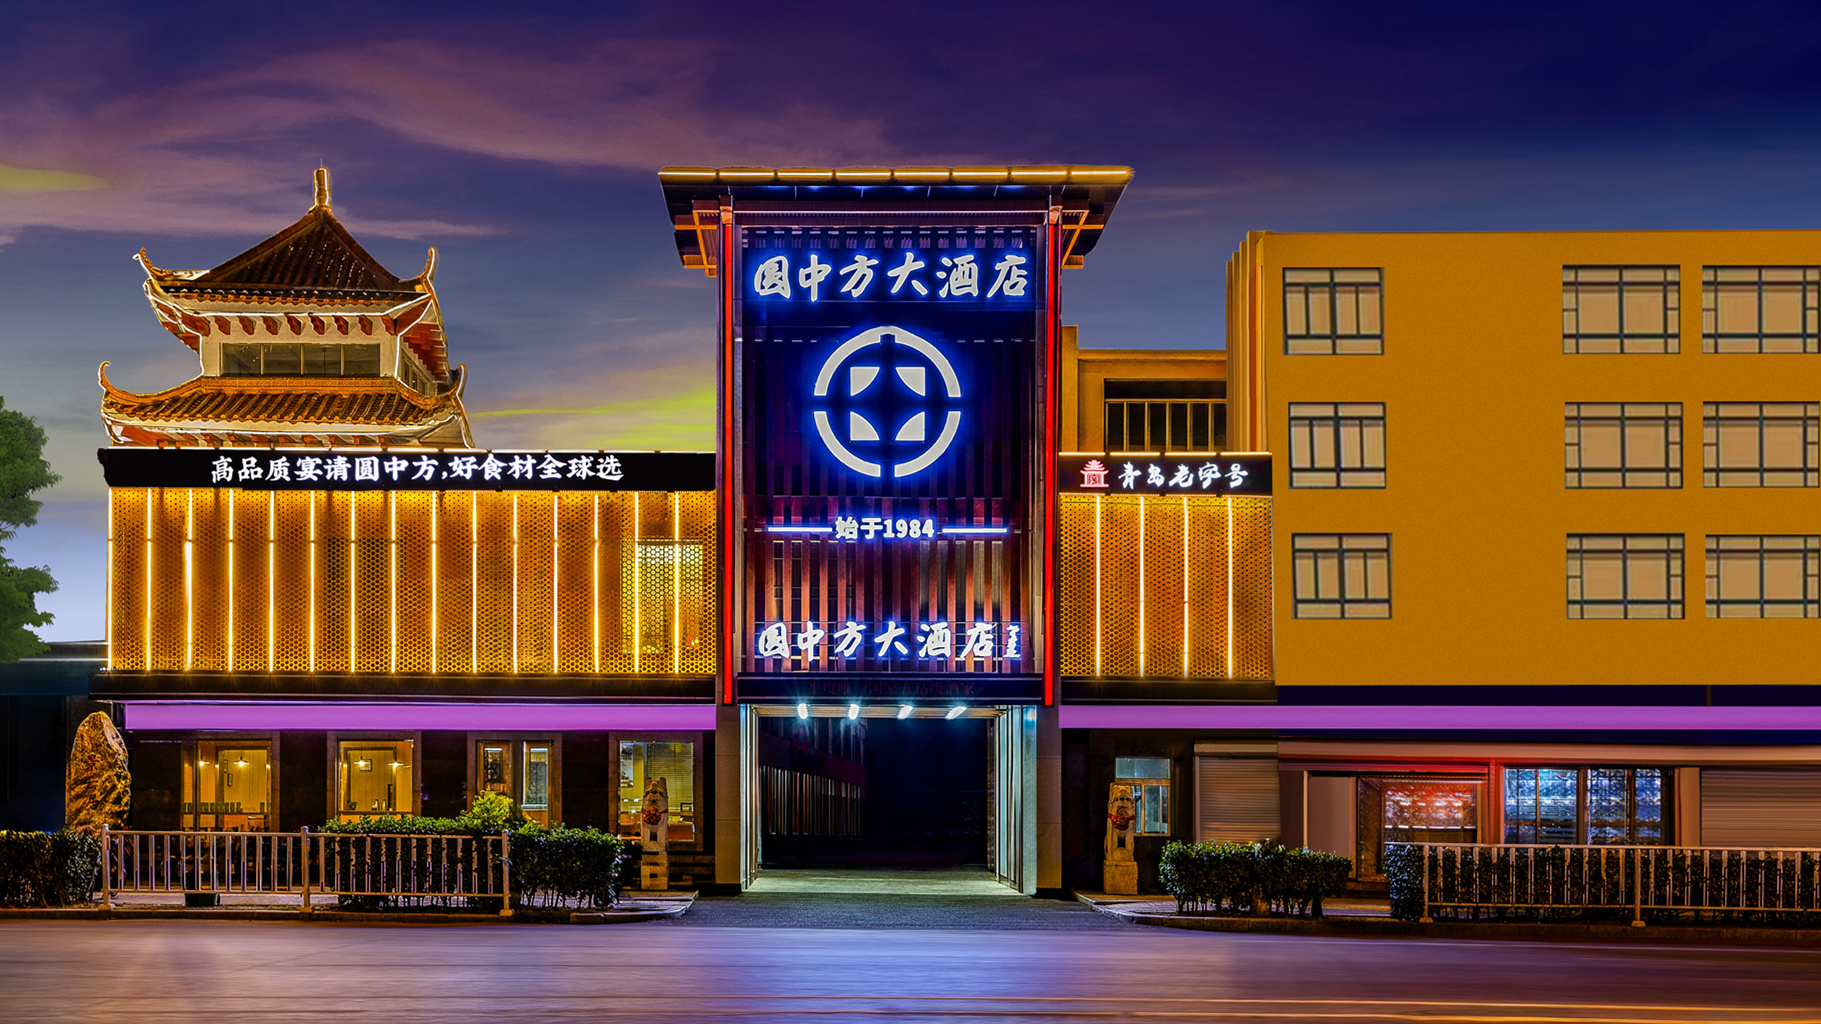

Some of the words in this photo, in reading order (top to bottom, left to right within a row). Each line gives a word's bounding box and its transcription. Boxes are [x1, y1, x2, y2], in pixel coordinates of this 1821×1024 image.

[754, 252, 1028, 302] 圆中方大酒店
[1118, 461, 1249, 490] 青岛老字号
[834, 516, 936, 541] 始于1984
[809, 681, 975, 696] 平度唯国家五钻级酒家
